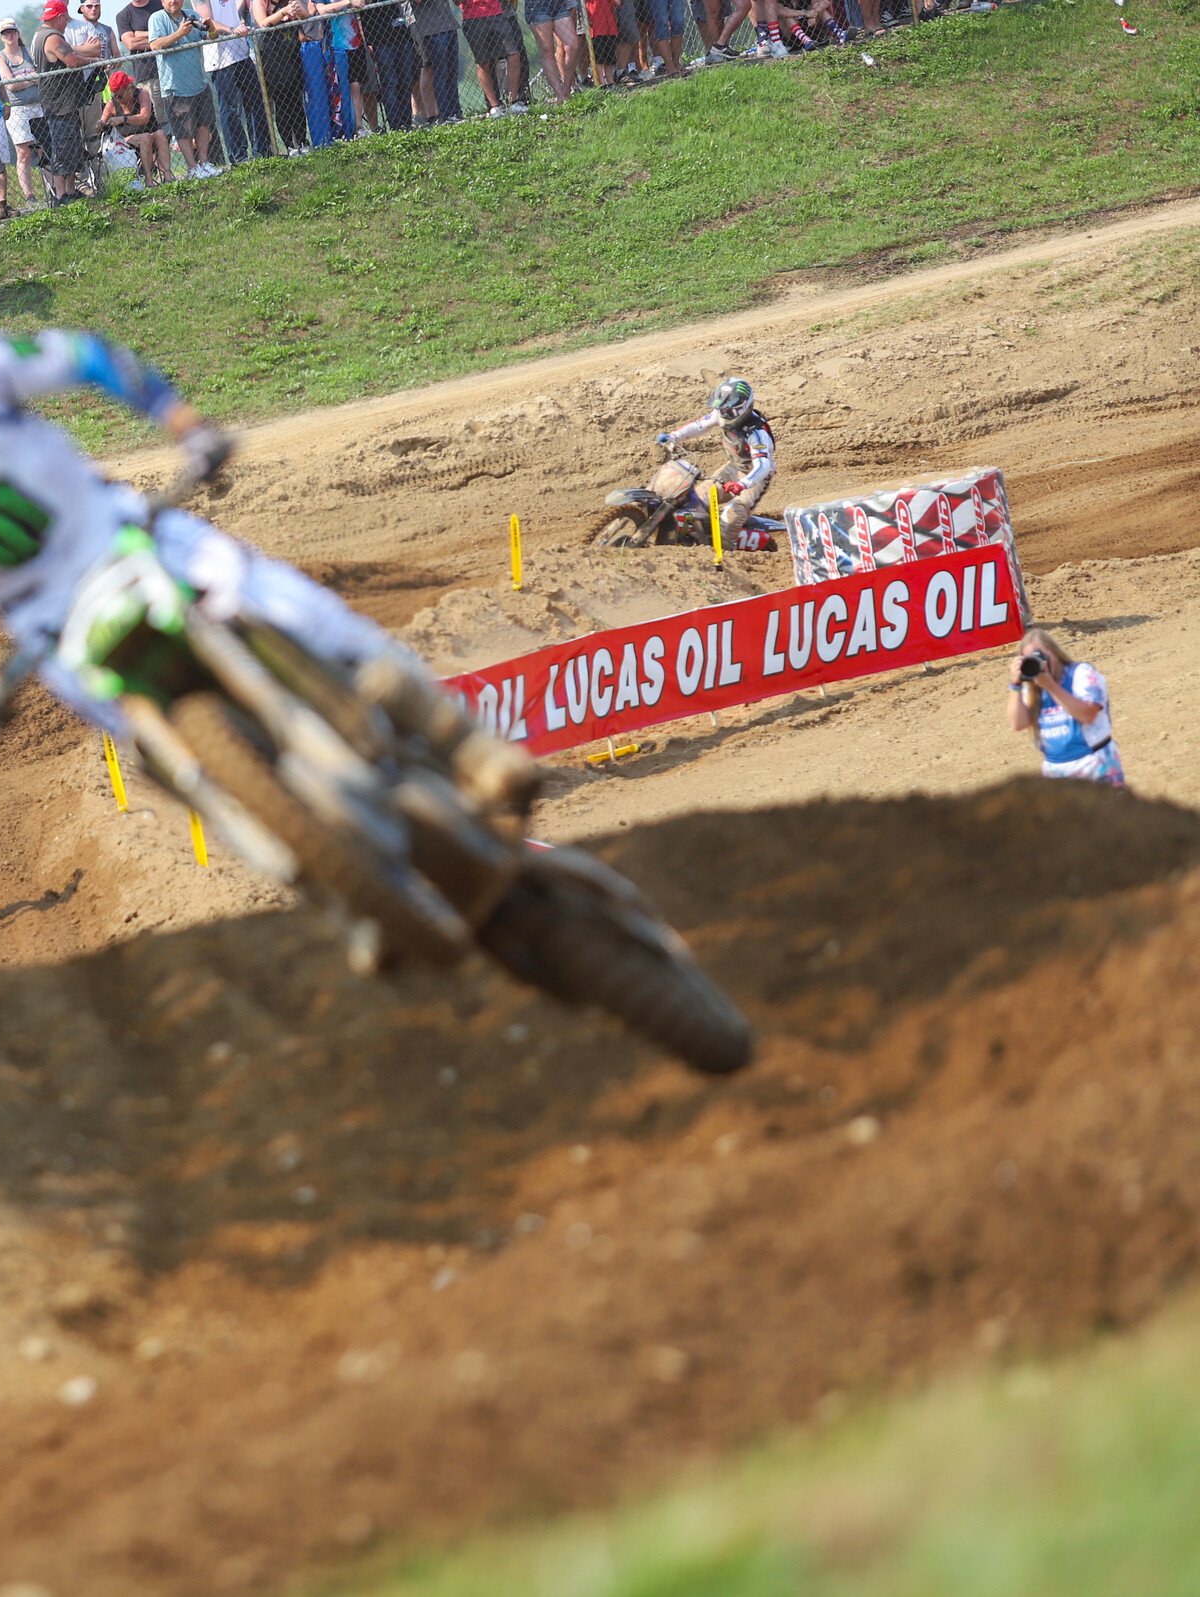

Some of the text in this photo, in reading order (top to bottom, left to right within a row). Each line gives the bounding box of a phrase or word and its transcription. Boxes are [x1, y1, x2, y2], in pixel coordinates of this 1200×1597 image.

[545, 635, 665, 732] LUCAS
[676, 619, 742, 697] OIL
[763, 580, 910, 678] LUCAS
[924, 561, 1008, 639] OIL
